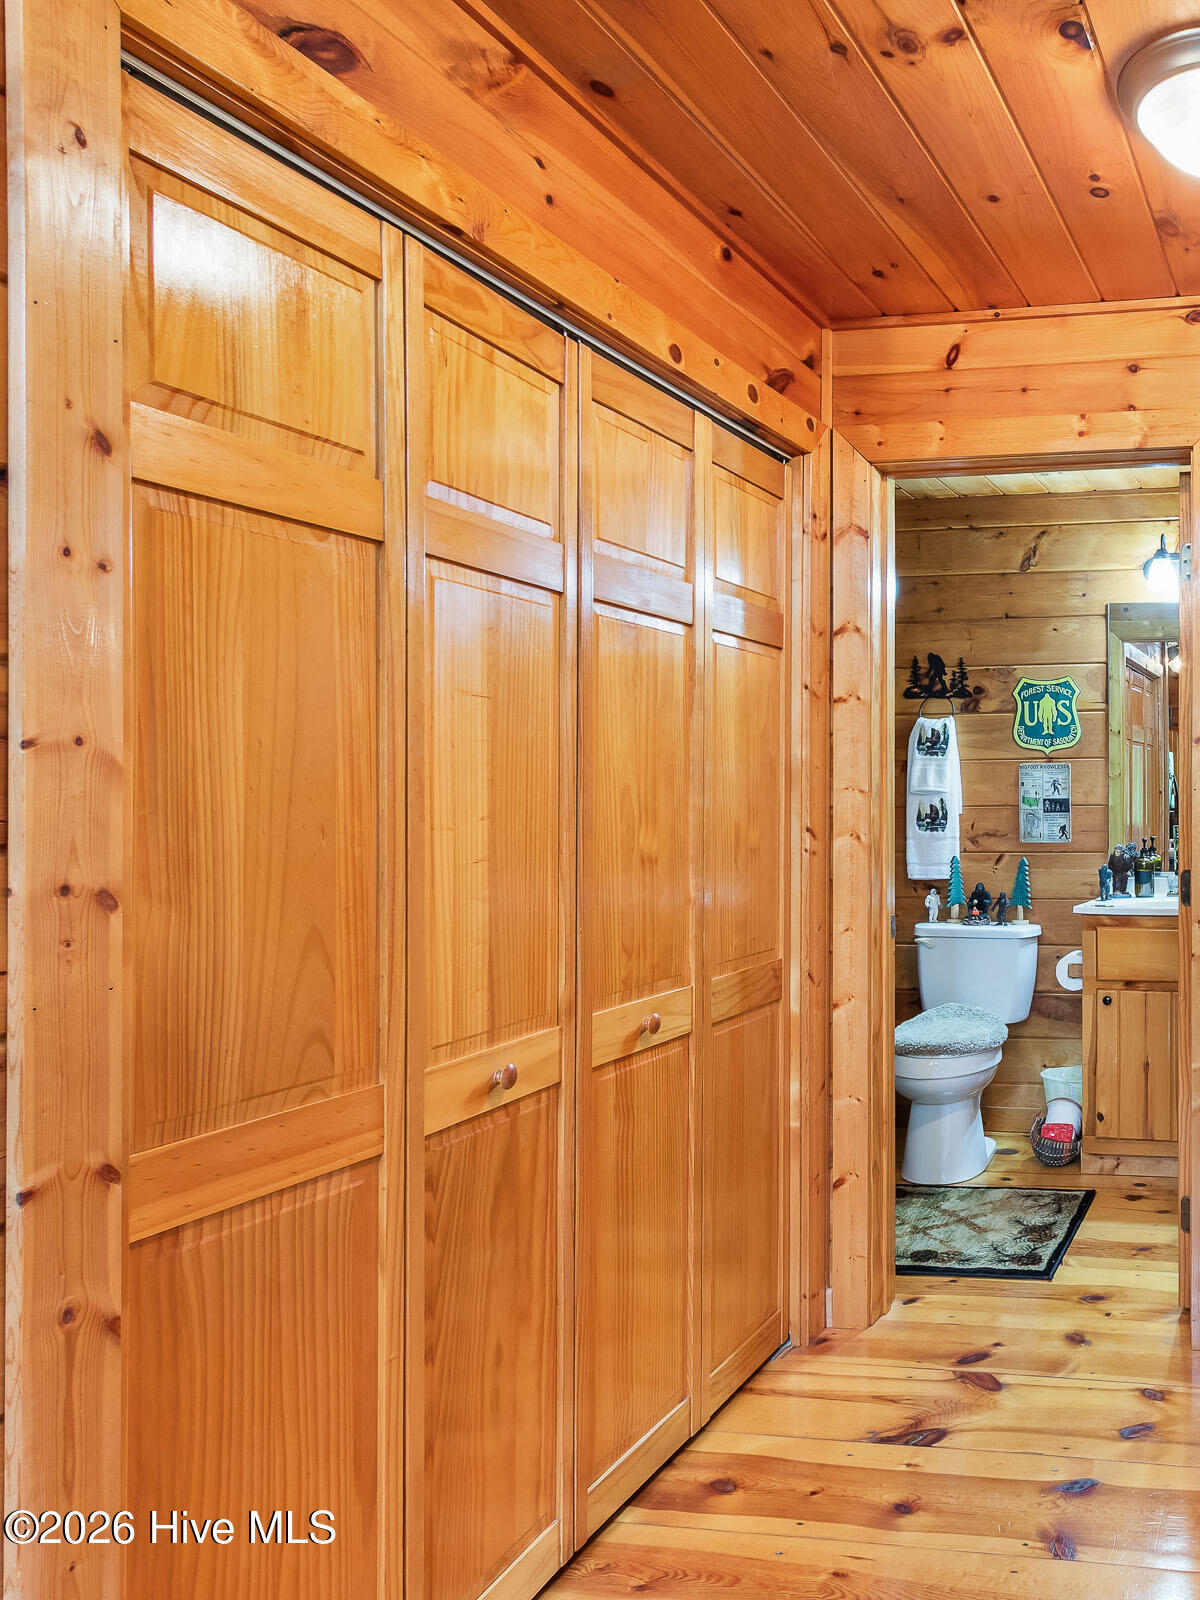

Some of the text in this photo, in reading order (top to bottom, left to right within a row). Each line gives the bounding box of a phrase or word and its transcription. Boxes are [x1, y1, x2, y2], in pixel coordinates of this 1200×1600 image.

[1021, 684, 1072, 699] FOREST SERVICE
[1018, 724, 1077, 748] DEPARTMENT OF SASQUATCH
